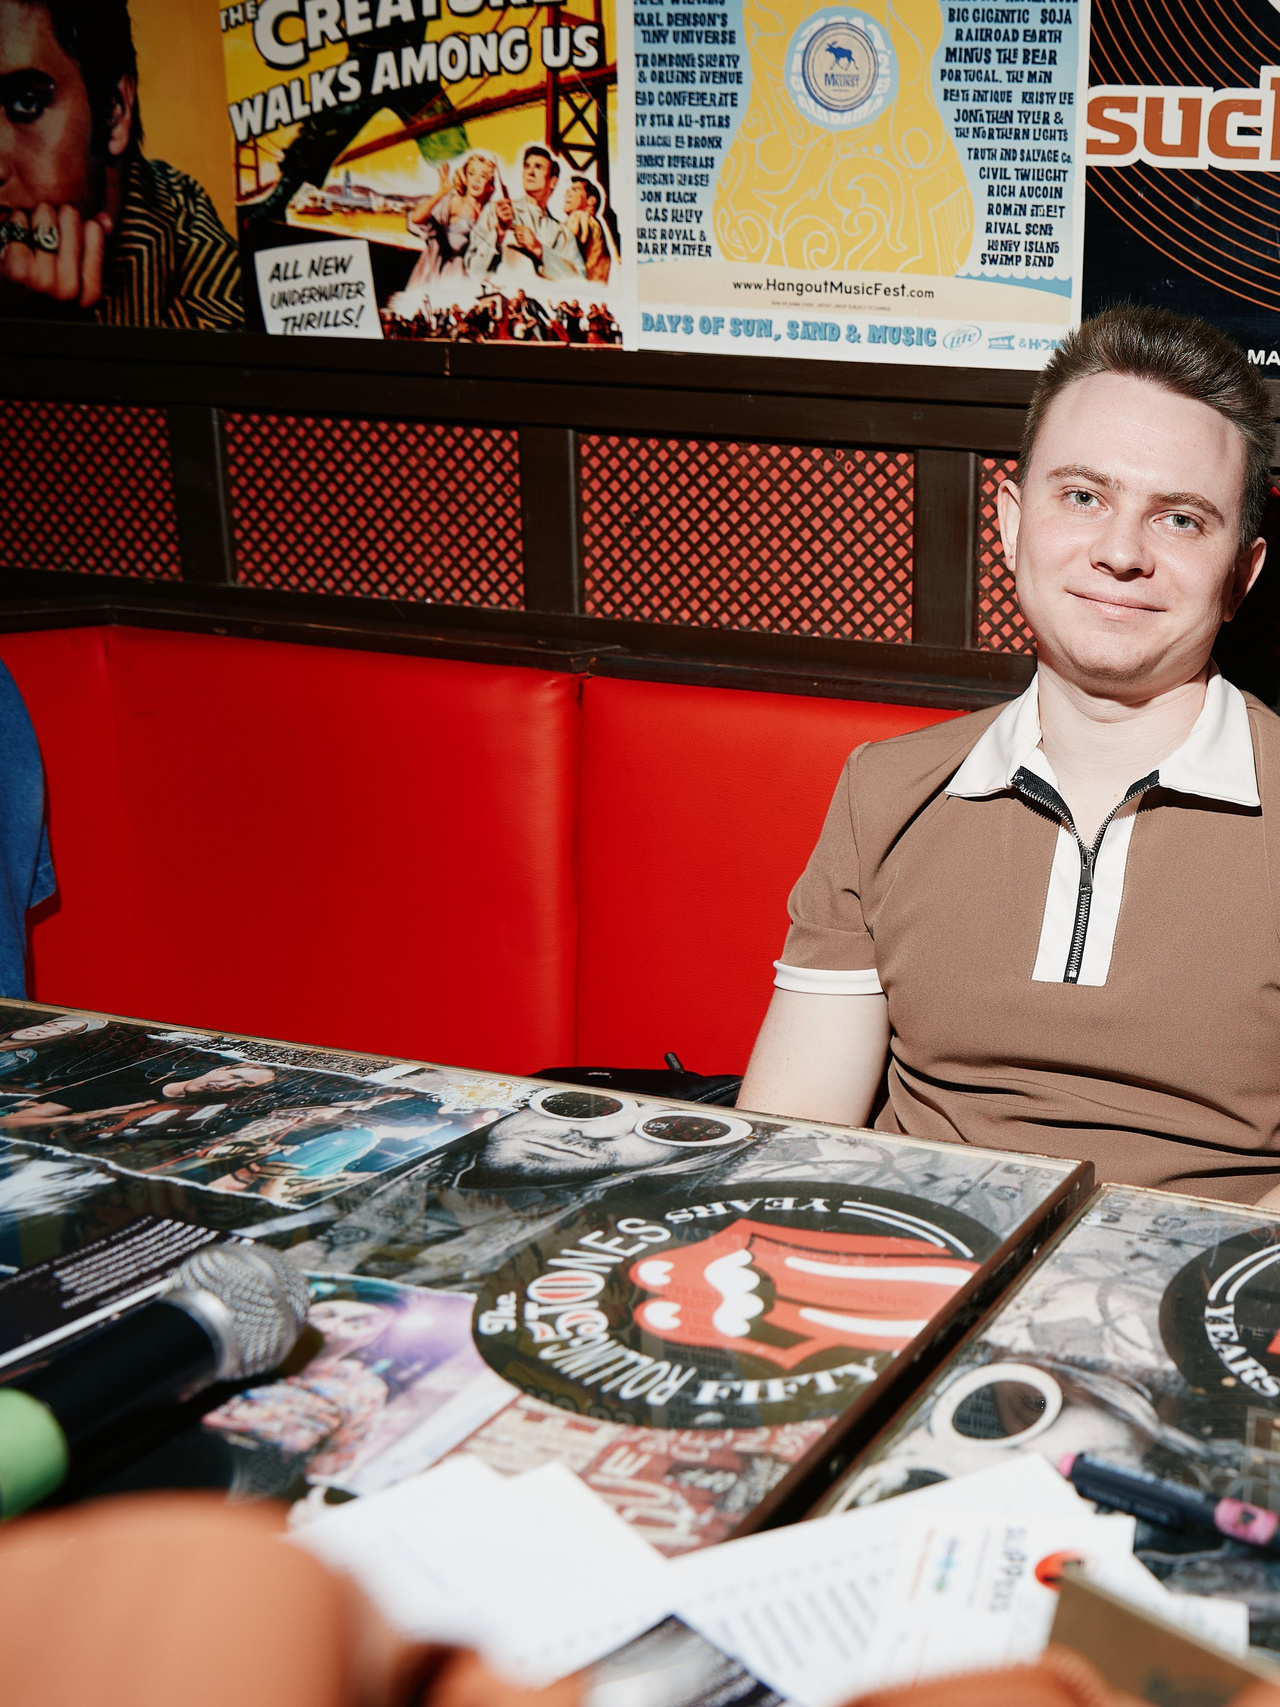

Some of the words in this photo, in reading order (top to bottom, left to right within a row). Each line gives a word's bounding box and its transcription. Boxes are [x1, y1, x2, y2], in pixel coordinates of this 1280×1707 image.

[219, 0, 258, 31] THE
[634, 12, 663, 27] KARL
[667, 12, 728, 28] DENSON'S
[948, 7, 969, 23] BIG
[972, 8, 1030, 24] GIGANTIC
[1040, 8, 1072, 25] SOJA
[641, 29, 669, 44] TINY
[673, 29, 736, 45] UNIVERSE
[955, 28, 1020, 42] RAILROAD
[1022, 29, 1062, 43] EARTH
[635, 53, 696, 68] TROMBONE
[697, 53, 740, 69] SHORTY
[944, 47, 992, 65] MINUS
[996, 48, 1018, 65] THE
[1022, 48, 1058, 66] BEAR
[228, 60, 361, 142] WALKS
[370, 27, 530, 95] AMONG
[541, 25, 600, 67] US
[638, 70, 647, 84] &
[650, 70, 696, 85] ORLEANS
[699, 70, 743, 85] AVENUE
[941, 68, 1002, 84] PORTUGAL.
[1006, 70, 1024, 84] THE
[1027, 70, 1052, 84] MAN
[657, 91, 738, 107] CONFEDERATE
[943, 88, 970, 102] BEATS
[972, 89, 1013, 103] ANTIQUE
[1021, 91, 1057, 105] KRISTY
[1059, 91, 1074, 105] LEE
[649, 113, 674, 127] STAR
[677, 114, 731, 129] ALL-STARS
[953, 109, 1014, 124] JONATHAN
[1017, 110, 1051, 125] TYLER
[1053, 111, 1064, 125] &
[687, 135, 723, 149] BRONX
[954, 127, 970, 139] THE
[972, 127, 1031, 141] NORTHERN
[1033, 128, 1069, 142] LIGHTS
[967, 147, 997, 160] TRUTH
[1000, 148, 1018, 161] AND
[1020, 148, 1059, 163] SALVAGE
[979, 167, 1012, 180] CIVIL
[1014, 168, 1069, 182] TWILIGHT
[640, 190, 662, 203] JON
[666, 191, 698, 204] BLACK
[987, 184, 1016, 198] RICH
[1019, 185, 1063, 199] AUCOIN
[645, 208, 669, 223] CAS
[671, 208, 703, 224] HALEY
[987, 203, 1027, 217] ROMAN
[1030, 204, 1066, 218] STREET
[660, 228, 696, 242] ROYAL
[699, 230, 708, 243] &
[985, 221, 1022, 235] RIVAL
[637, 241, 667, 256] DARK
[671, 243, 712, 258] MATTER
[987, 239, 1020, 253] HONEY
[1024, 240, 1060, 254] ISLAND
[269, 260, 302, 282] ALL
[308, 254, 353, 277] NEW
[980, 253, 1022, 266] SWAMP
[1025, 254, 1055, 268] BAND
[270, 281, 366, 310] UNDERWATER
[732, 278, 934, 299] www.HangoutMusicFest.com
[281, 304, 365, 336] THRILLS!
[641, 312, 695, 335] DAYS
[699, 315, 725, 336] OF
[729, 317, 781, 342] SUN,
[786, 319, 841, 343] SAND
[845, 324, 862, 345] &
[867, 323, 937, 348] MUSIC
[664, 1196, 831, 1224] YEARS
[524, 1217, 672, 1344] STONES
[478, 1290, 517, 1336] The
[689, 1355, 879, 1406] FIFTY
